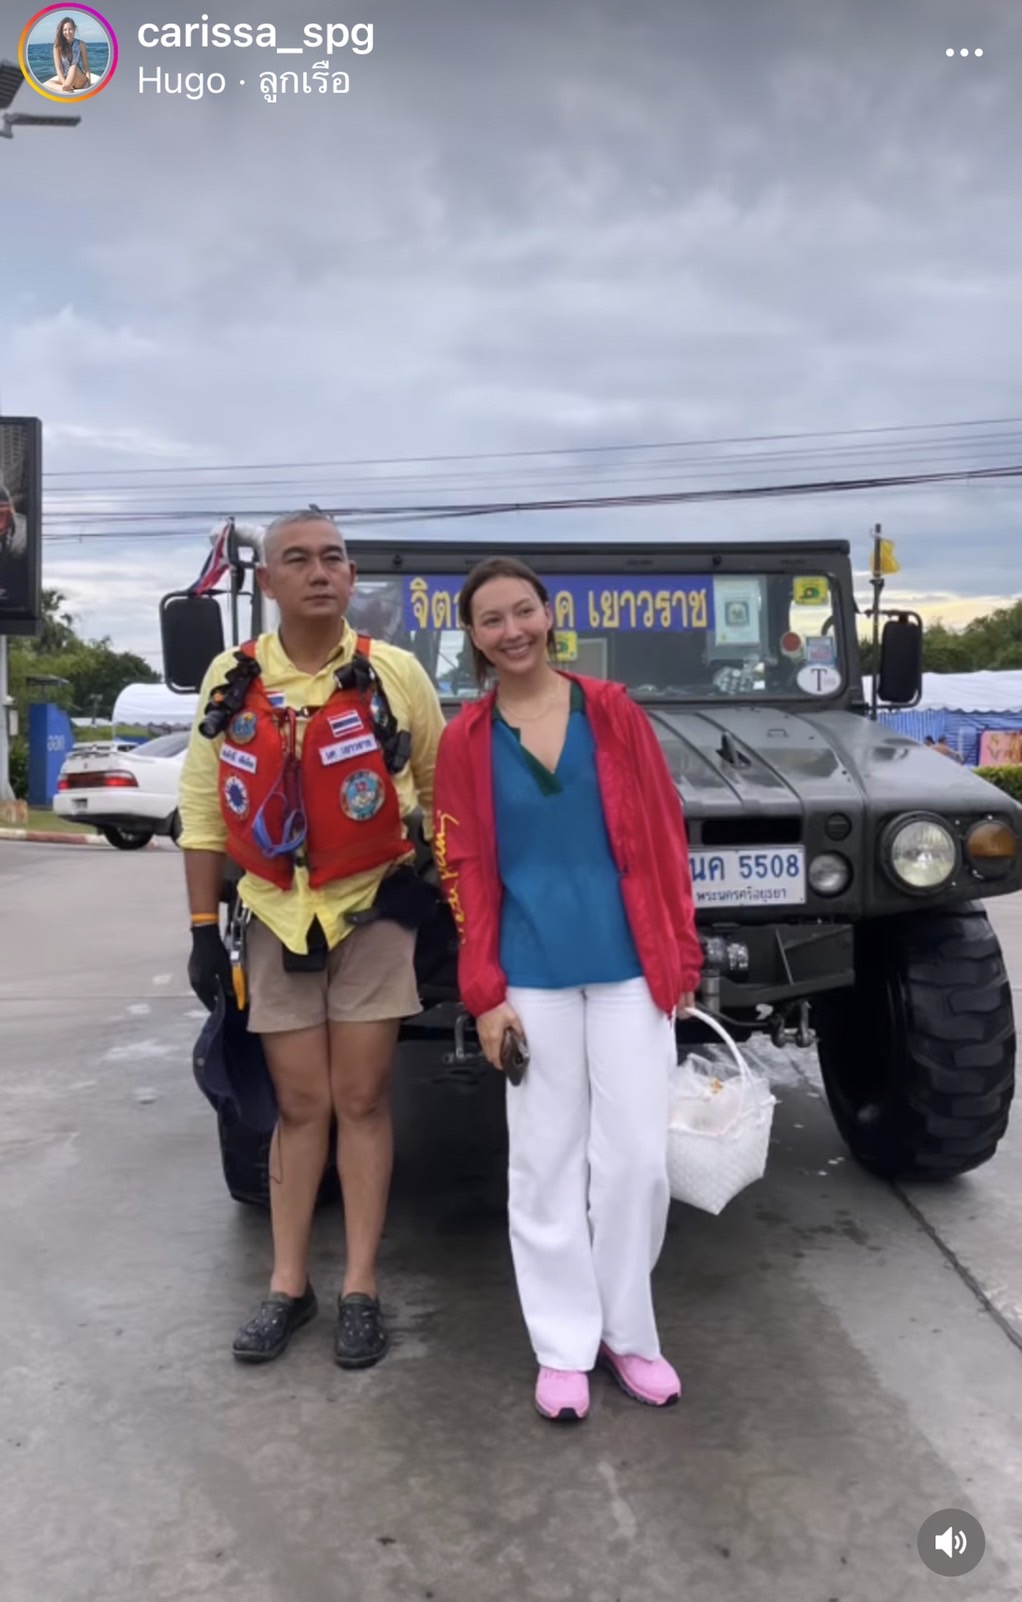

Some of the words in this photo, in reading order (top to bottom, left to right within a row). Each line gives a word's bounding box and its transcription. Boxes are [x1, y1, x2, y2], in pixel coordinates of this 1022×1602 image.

[587, 587, 708, 629] เยาวราช
[810, 668, 829, 692] T
[739, 853, 800, 880] 5508
